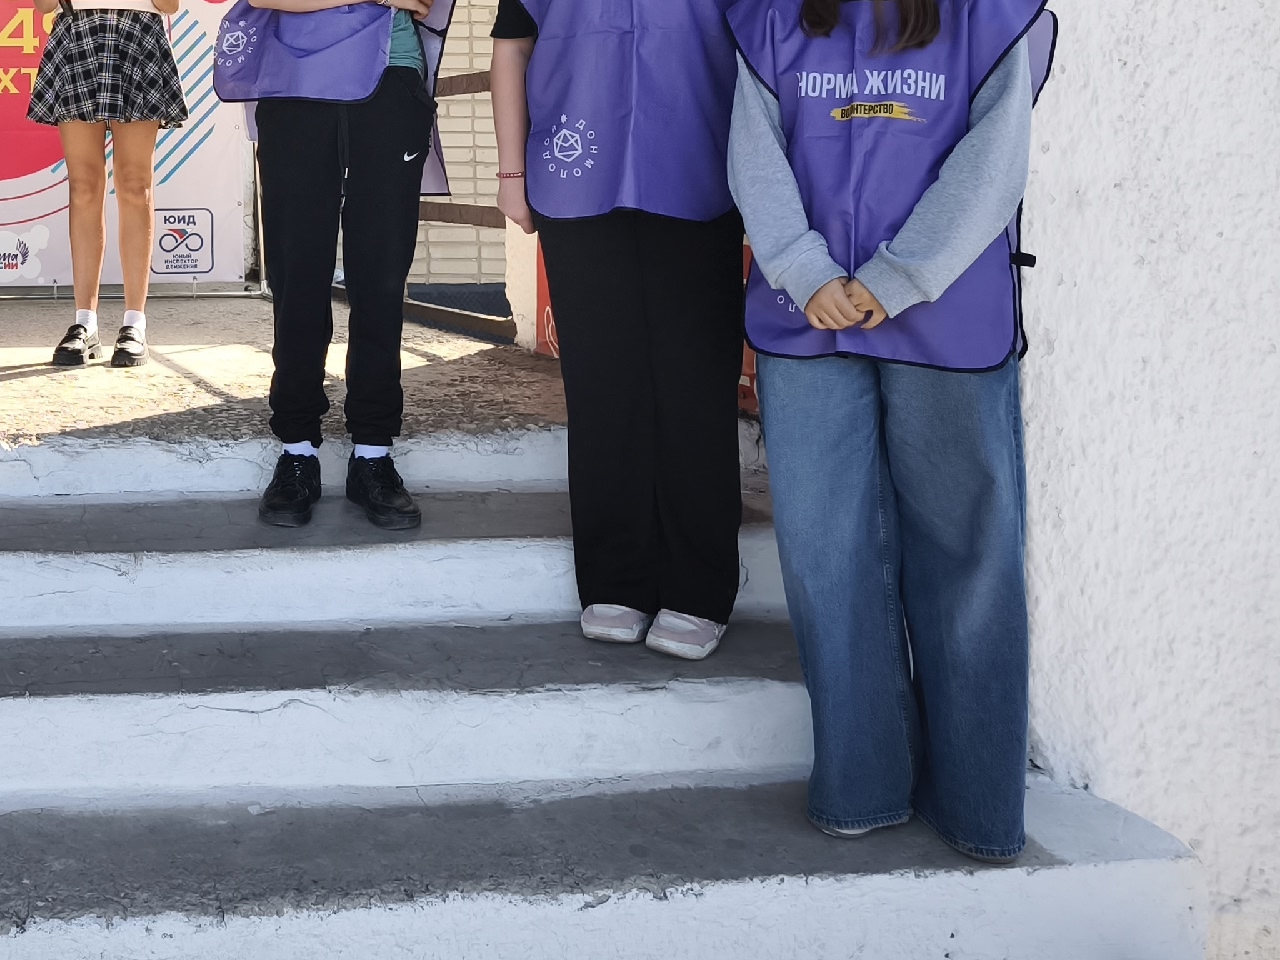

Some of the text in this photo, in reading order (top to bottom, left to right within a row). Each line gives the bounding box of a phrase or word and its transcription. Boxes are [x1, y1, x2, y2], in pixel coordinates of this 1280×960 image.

[796, 68, 946, 101] НОРМА ЖИЗНИ
[840, 103, 894, 119] ВОНТЕРСТВО
[163, 215, 197, 226] ЮИД
